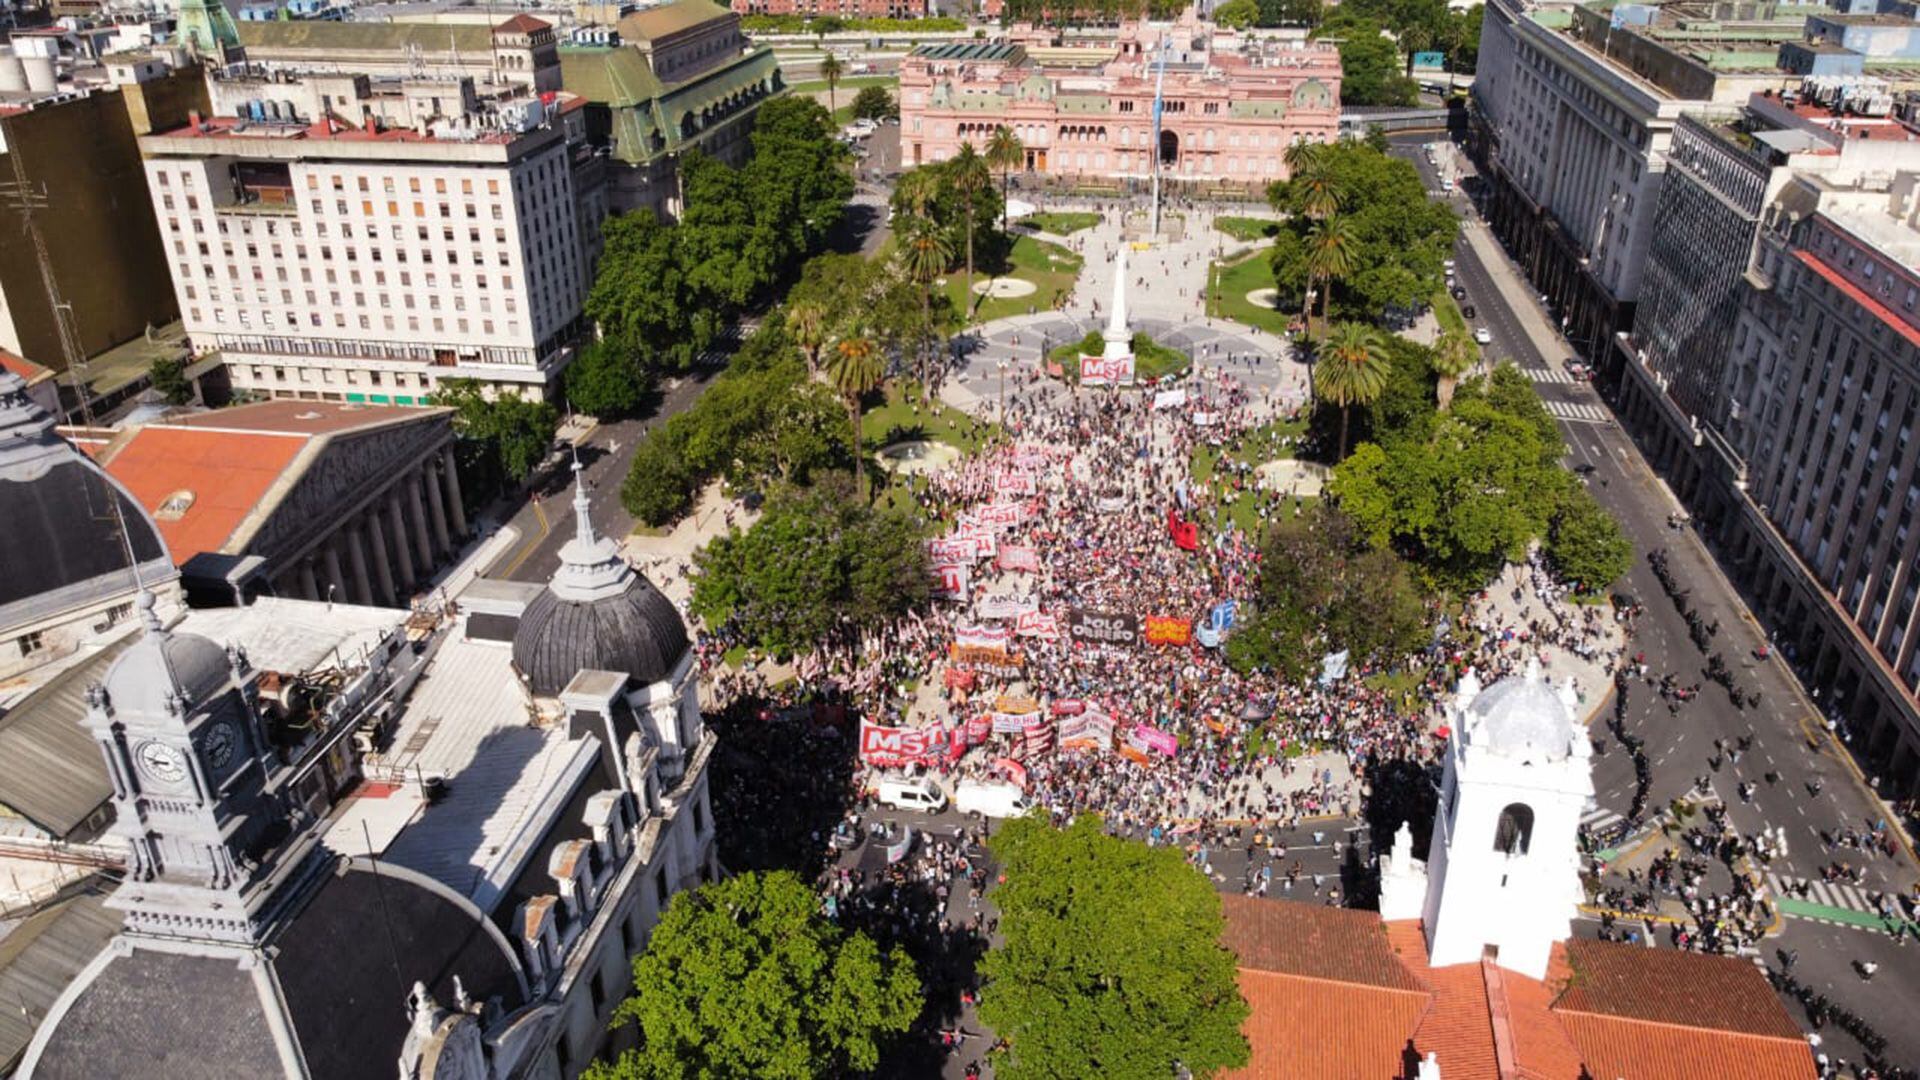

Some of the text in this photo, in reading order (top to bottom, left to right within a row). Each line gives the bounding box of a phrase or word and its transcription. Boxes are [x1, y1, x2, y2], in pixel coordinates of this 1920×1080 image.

[1081, 356, 1131, 380] MST
[1072, 624, 1134, 641] OBRERO
[1083, 615, 1125, 630] POLO
[864, 720, 947, 756] MST
